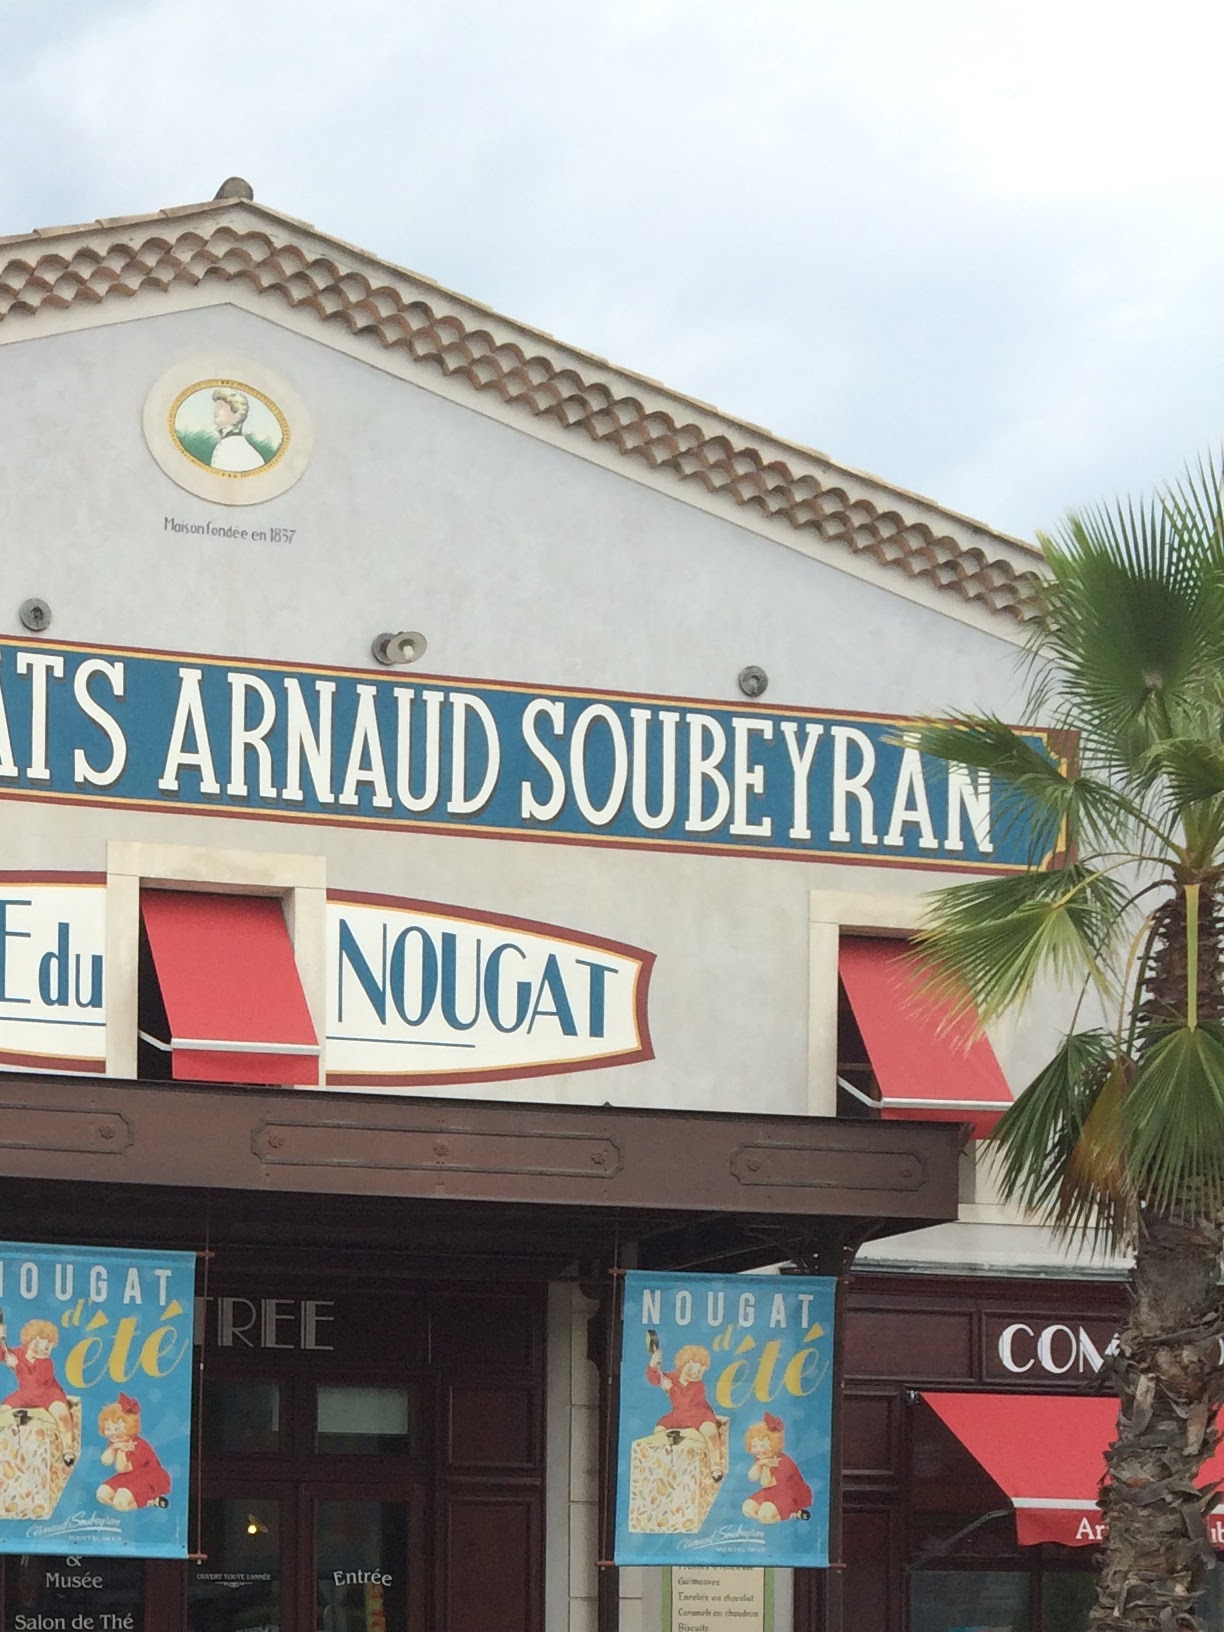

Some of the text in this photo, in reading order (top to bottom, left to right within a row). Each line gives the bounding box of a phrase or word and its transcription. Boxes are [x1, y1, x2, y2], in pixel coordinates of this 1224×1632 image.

[163, 516, 205, 535] Maison
[206, 520, 249, 540] fondée
[251, 529, 267, 542] en
[158, 667, 501, 815] ARNAUD
[520, 697, 995, 855] SOUBEYRAN
[38, 921, 104, 1010] du
[337, 916, 619, 1039] NOUGAT
[641, 1288, 814, 1329] NOUGAT
[45, 1571, 104, 1589] Musée
[333, 1567, 393, 1587] Entrée
[724, 1594, 754, 1602] chocolat
[14, 1612, 134, 1631] Salon de Thé
[678, 1623, 708, 1632] Biscuits
